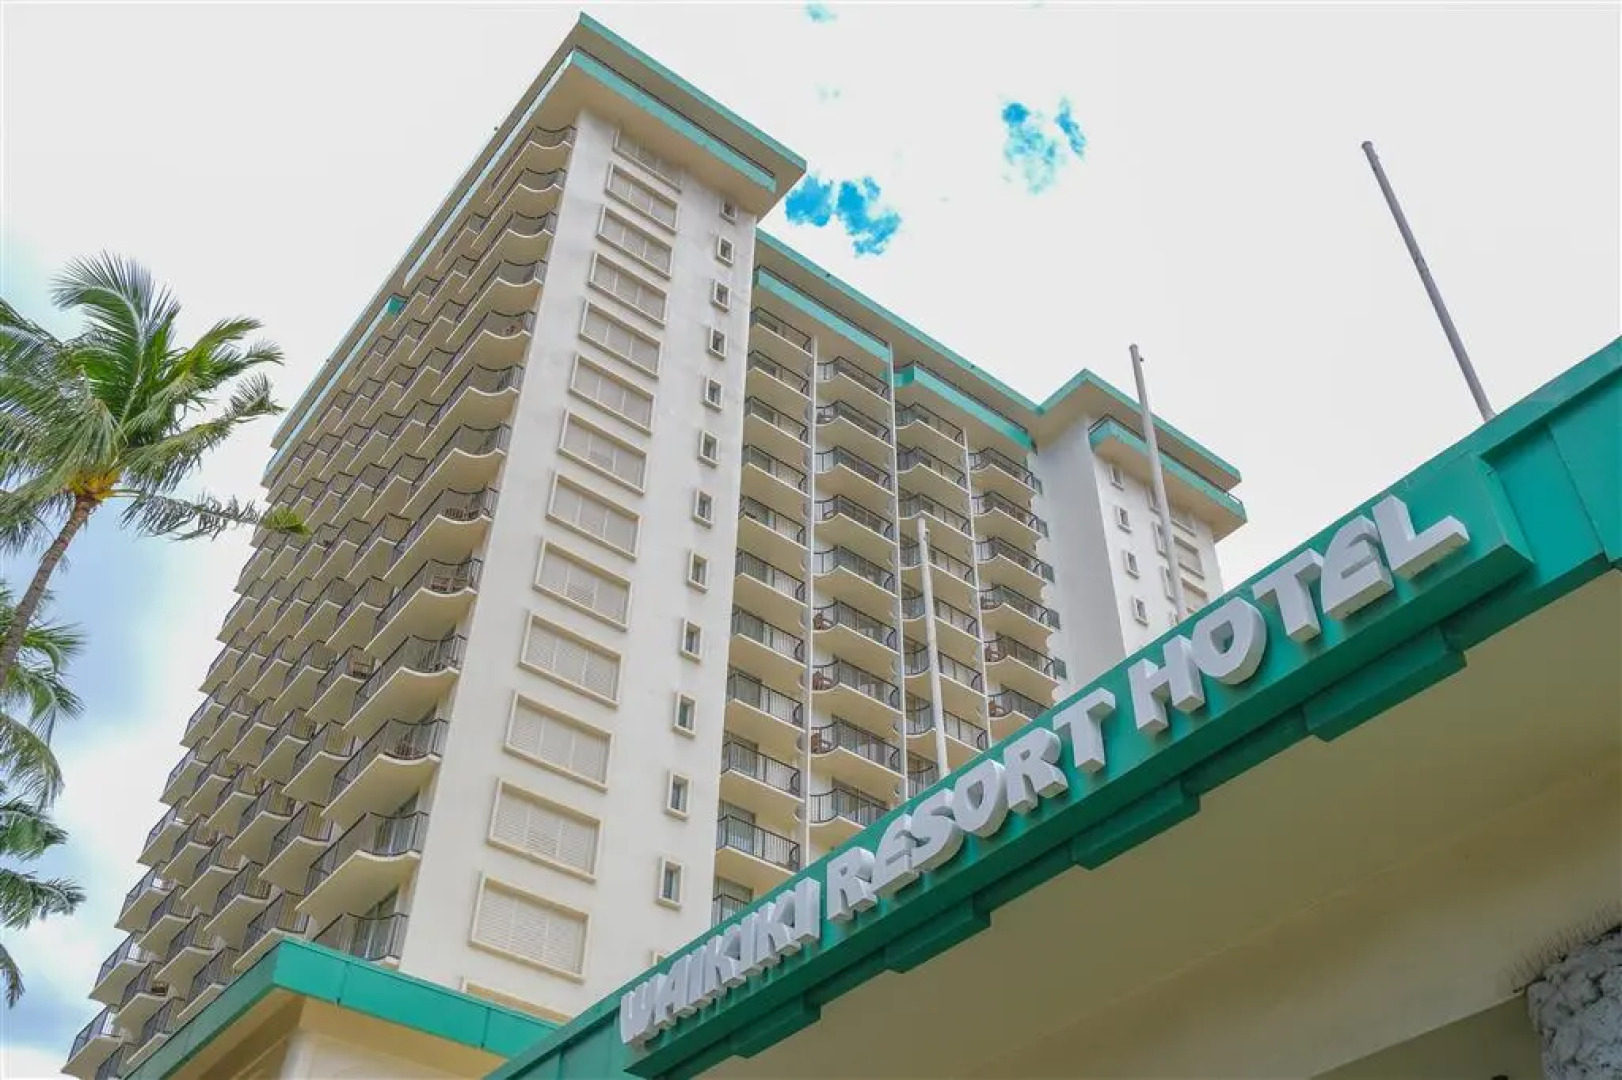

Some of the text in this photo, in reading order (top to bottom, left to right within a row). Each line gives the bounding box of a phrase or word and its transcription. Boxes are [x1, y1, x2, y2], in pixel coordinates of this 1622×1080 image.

[621, 495, 1470, 1046] WAIKIKI RESORT HOTEL
